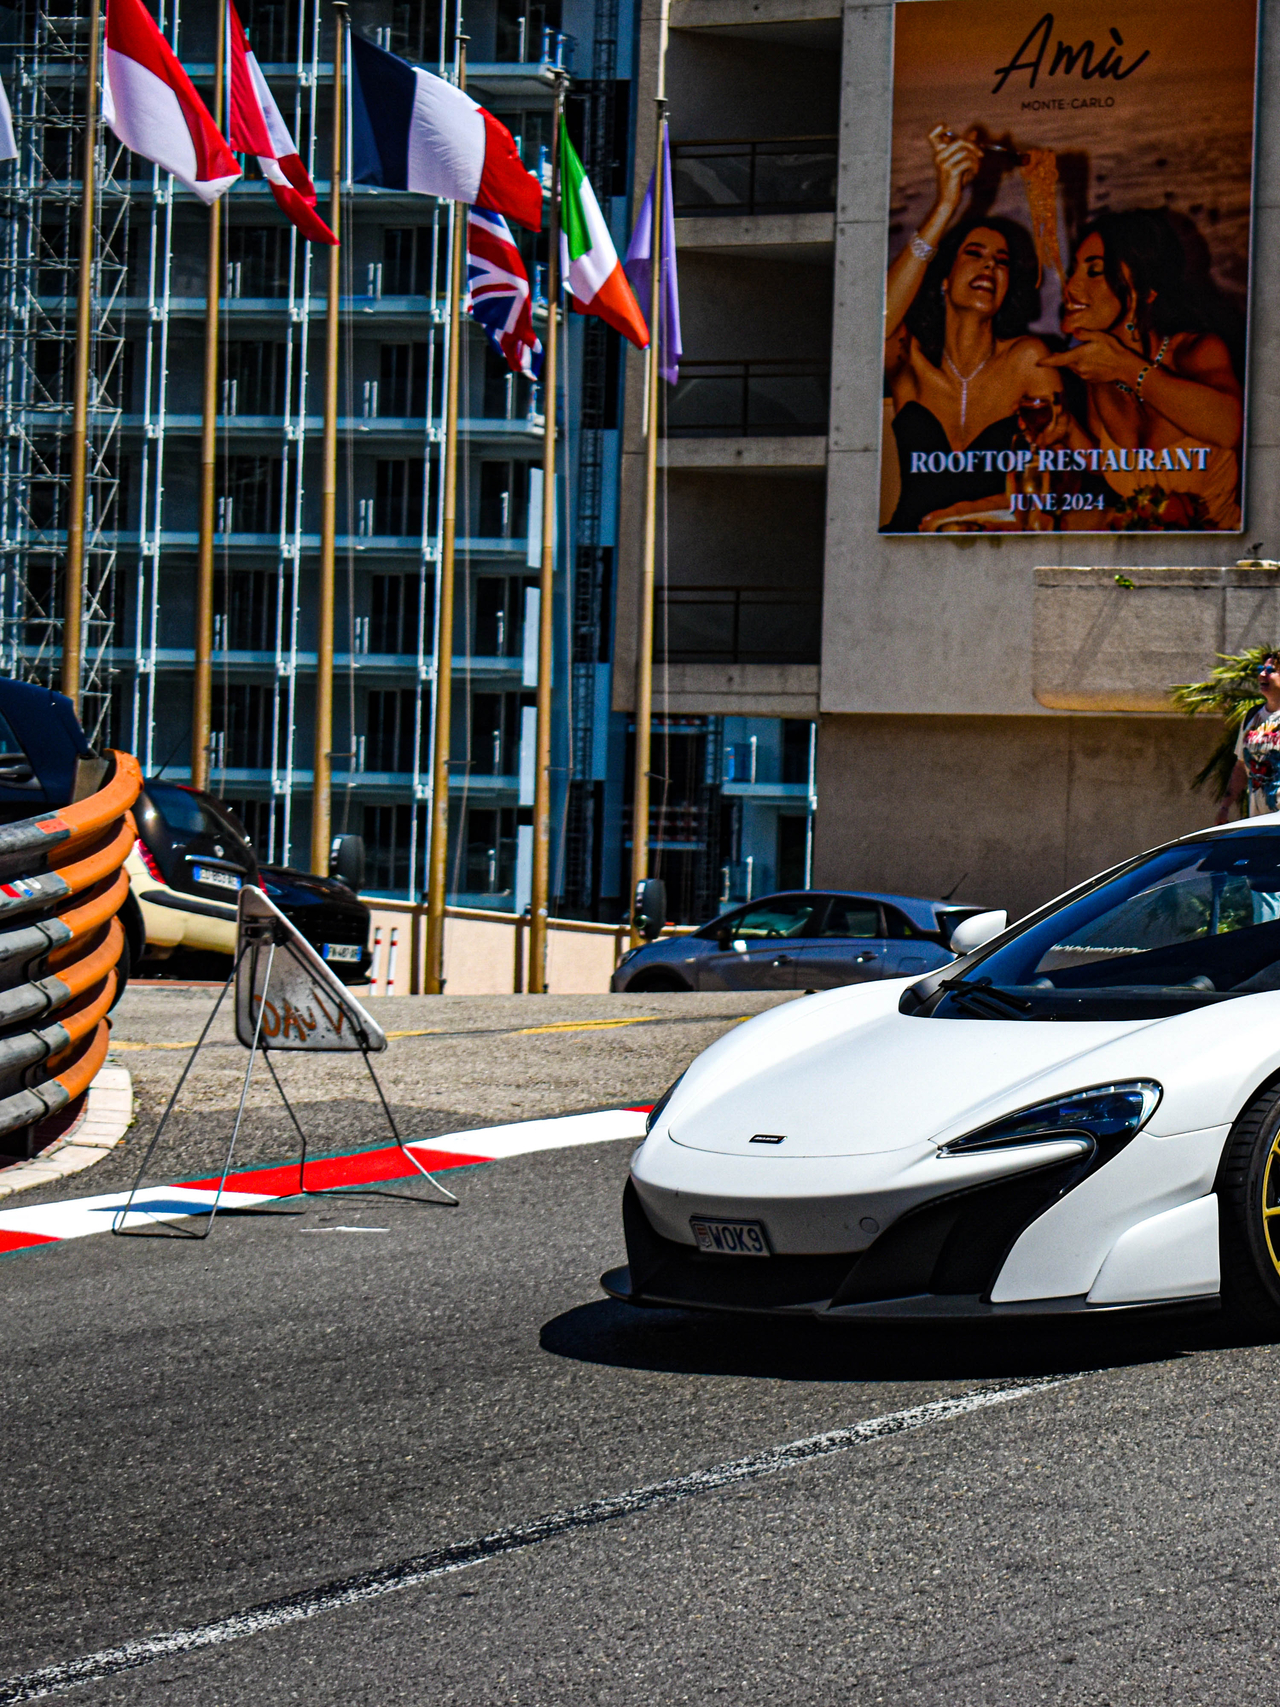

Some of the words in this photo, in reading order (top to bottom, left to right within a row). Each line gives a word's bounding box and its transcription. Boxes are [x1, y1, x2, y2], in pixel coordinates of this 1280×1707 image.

[991, 12, 1151, 94] Amù
[1021, 97, 1115, 111] MONTE-CARLO
[910, 449, 1031, 473] ROOFTOP
[1037, 447, 1211, 472] RESTAURANT
[1009, 493, 1057, 513] JUNE
[1062, 493, 1105, 511] 2024
